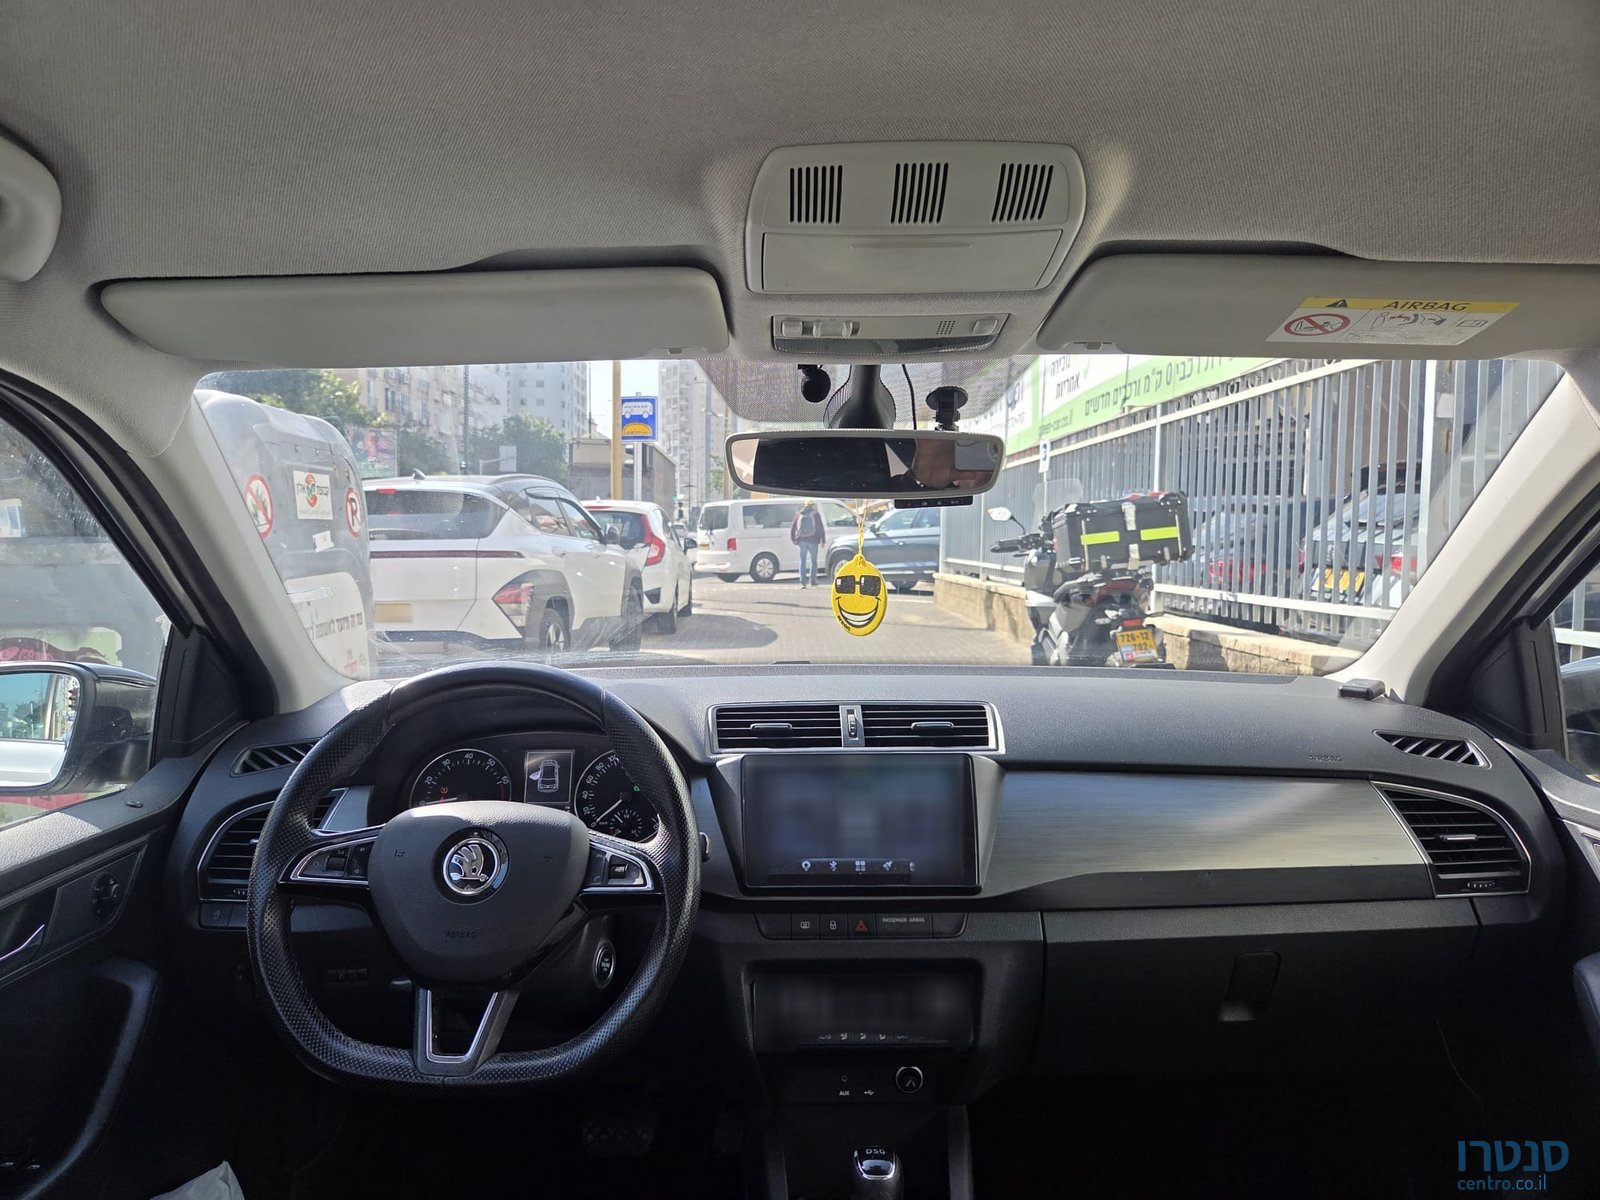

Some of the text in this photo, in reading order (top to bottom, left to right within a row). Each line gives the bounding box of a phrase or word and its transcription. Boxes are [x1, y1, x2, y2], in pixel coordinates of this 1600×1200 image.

[1384, 301, 1472, 312] AIRBAG
[1056, 371, 1081, 400] אחריות
[1084, 391, 1110, 417] חדשים
[441, 758, 451, 767] 30
[425, 776, 433, 785] 20
[445, 930, 478, 939] AIRBAG
